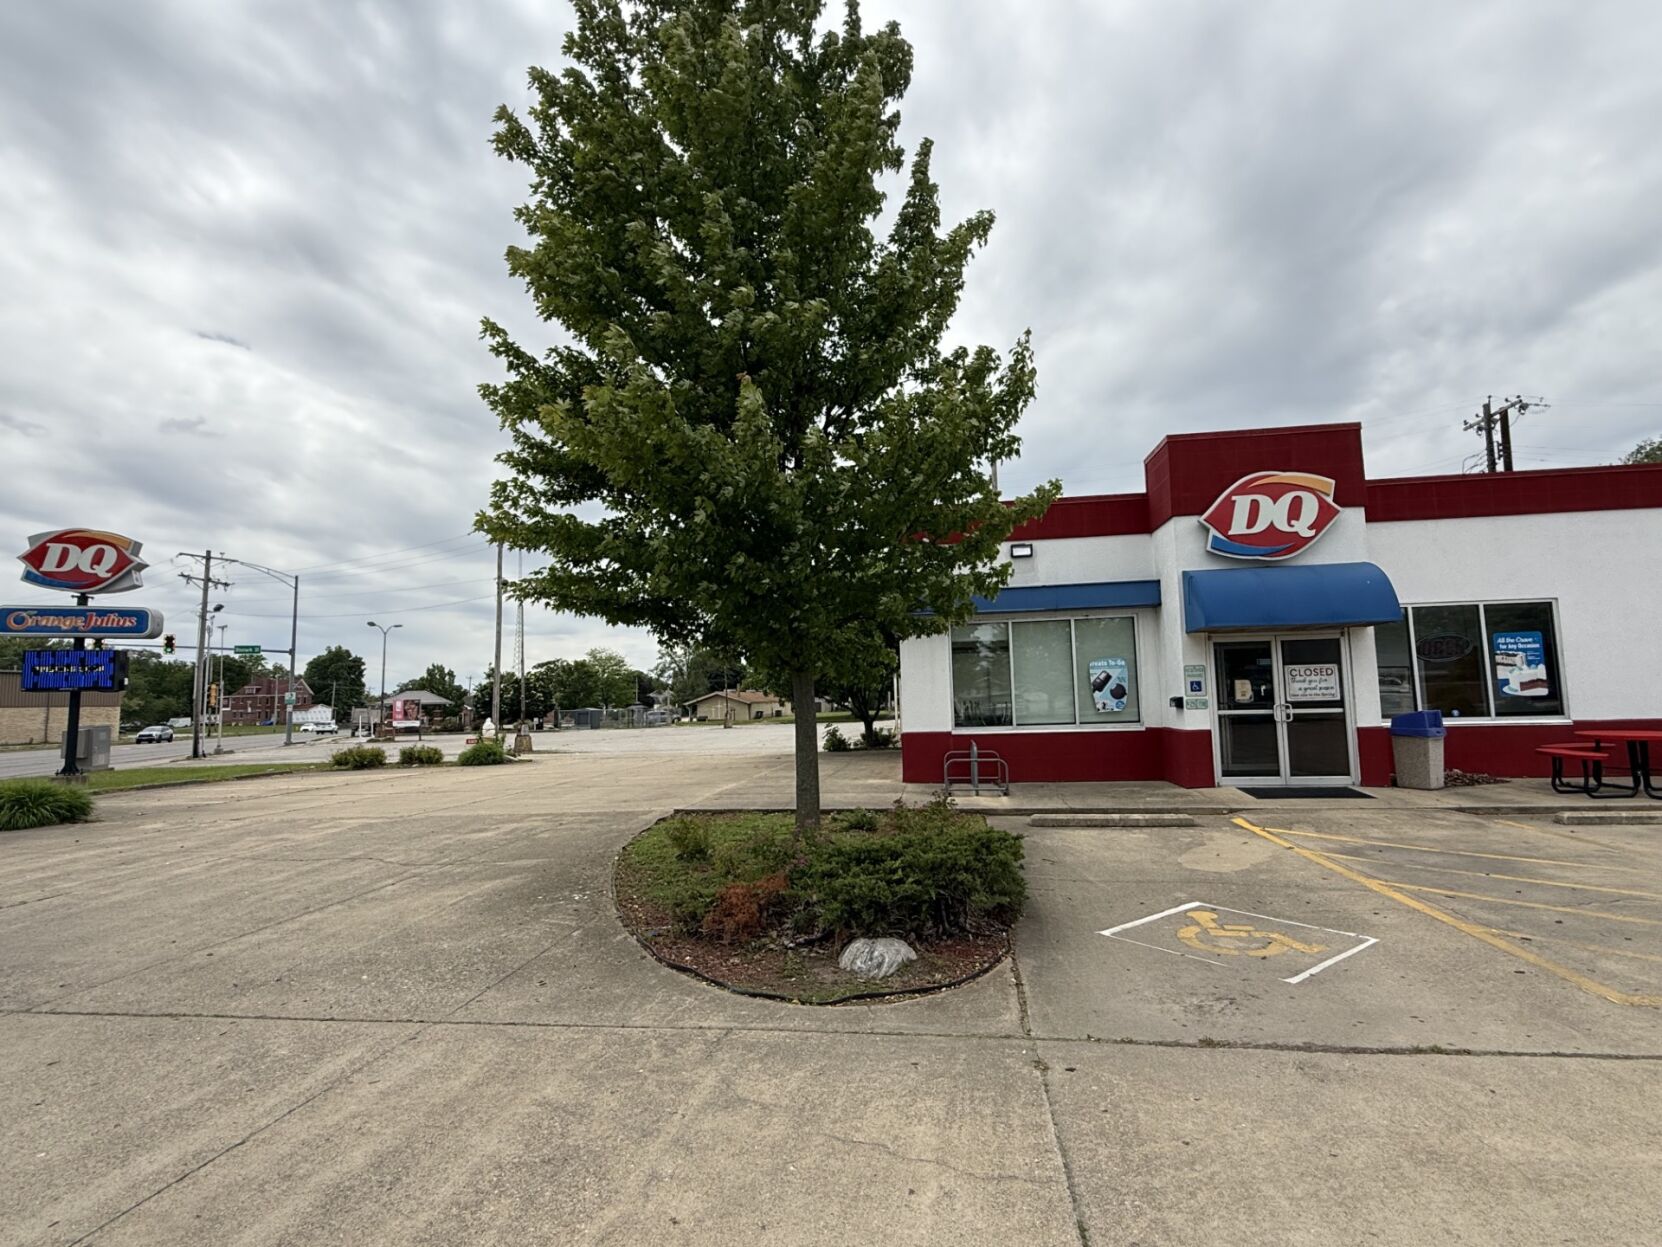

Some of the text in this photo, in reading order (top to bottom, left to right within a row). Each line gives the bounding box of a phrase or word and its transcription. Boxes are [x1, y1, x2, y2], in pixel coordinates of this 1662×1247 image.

[1228, 490, 1319, 537] DQ
[39, 543, 118, 578] DQ
[6, 611, 137, 632] Orange Julius
[1289, 667, 1334, 677] CLOSED
